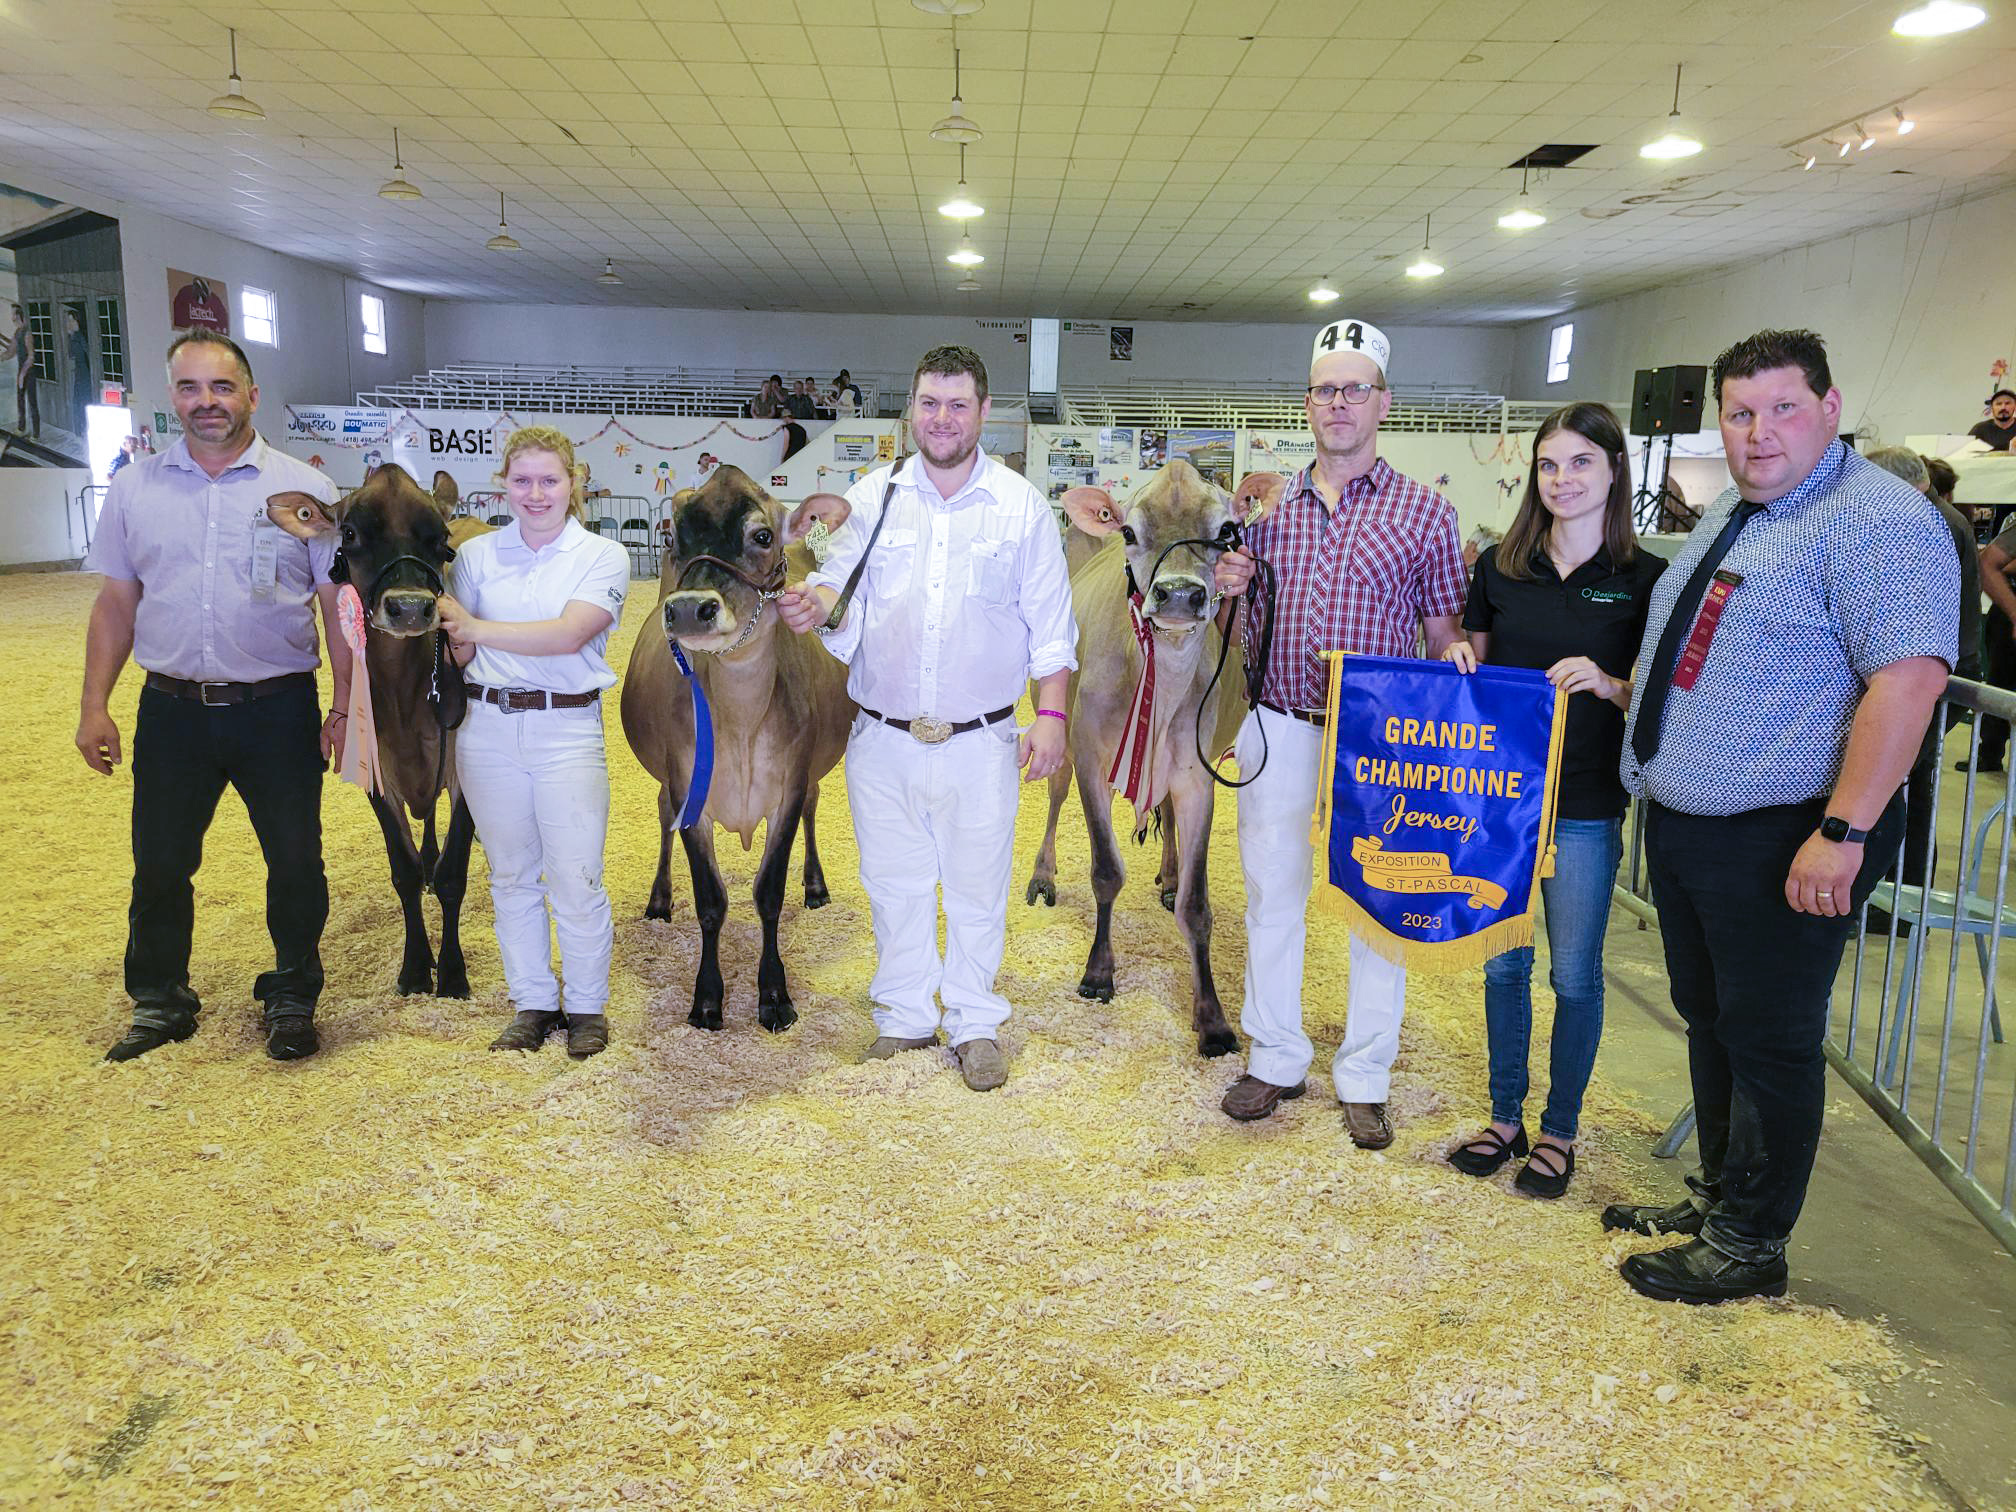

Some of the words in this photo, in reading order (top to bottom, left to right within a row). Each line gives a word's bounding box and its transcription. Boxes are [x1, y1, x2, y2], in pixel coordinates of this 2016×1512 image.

[1320, 323, 1364, 350] 44
[344, 420, 386, 428] BOUMATIC
[1593, 590, 1633, 601] Desjardins
[1385, 716, 1497, 752] GRANDE
[1355, 756, 1523, 799] CHAMPIONNE
[1382, 793, 1479, 844] Jersey
[1359, 851, 1441, 867] EXPOSITION
[1385, 878, 1483, 894] ST-PASCAL
[1401, 912, 1442, 929] 2023
